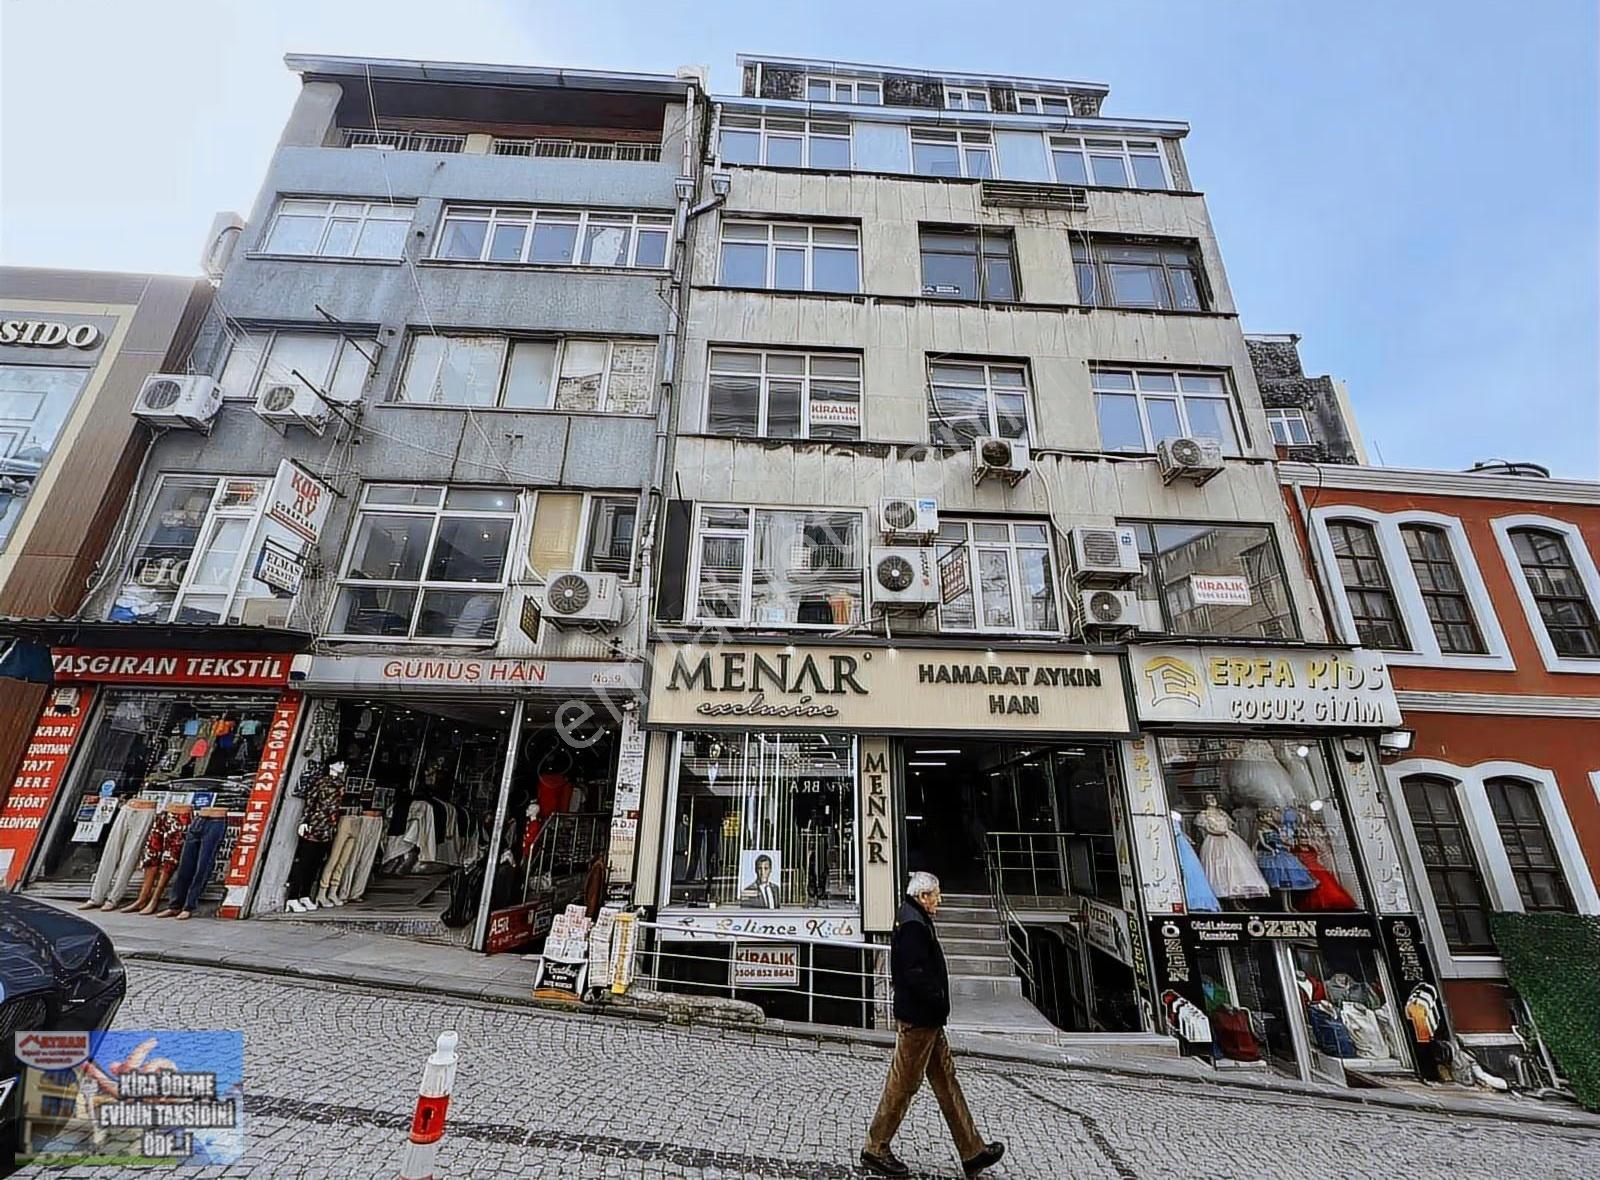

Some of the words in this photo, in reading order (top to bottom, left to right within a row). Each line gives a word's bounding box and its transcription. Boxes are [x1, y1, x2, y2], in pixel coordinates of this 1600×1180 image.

[1195, 579, 1246, 592] KİRALIK
[186, 656, 283, 678] TEKSTİL
[384, 659, 481, 683] GÜMÜŞ
[490, 663, 546, 682] HAN
[666, 650, 869, 695] MENAR
[918, 664, 1030, 686] HAMARAT
[1034, 668, 1102, 687] AYKIN
[1209, 655, 1296, 689] ERFA
[1304, 654, 1385, 692] KİDS
[697, 693, 838, 718] exclusive
[988, 694, 1040, 715] HAN
[35, 723, 76, 737] KAPRİ
[22, 760, 55, 771] TAYT
[14, 777, 51, 788] BERE
[863, 752, 888, 864] MENAR
[805, 919, 855, 939] Kids
[1247, 916, 1317, 938] ÖZEN
[735, 949, 795, 966] KİRALIK
[1161, 920, 1190, 982] ÖZEN
[1393, 920, 1424, 982] ÖZEN
